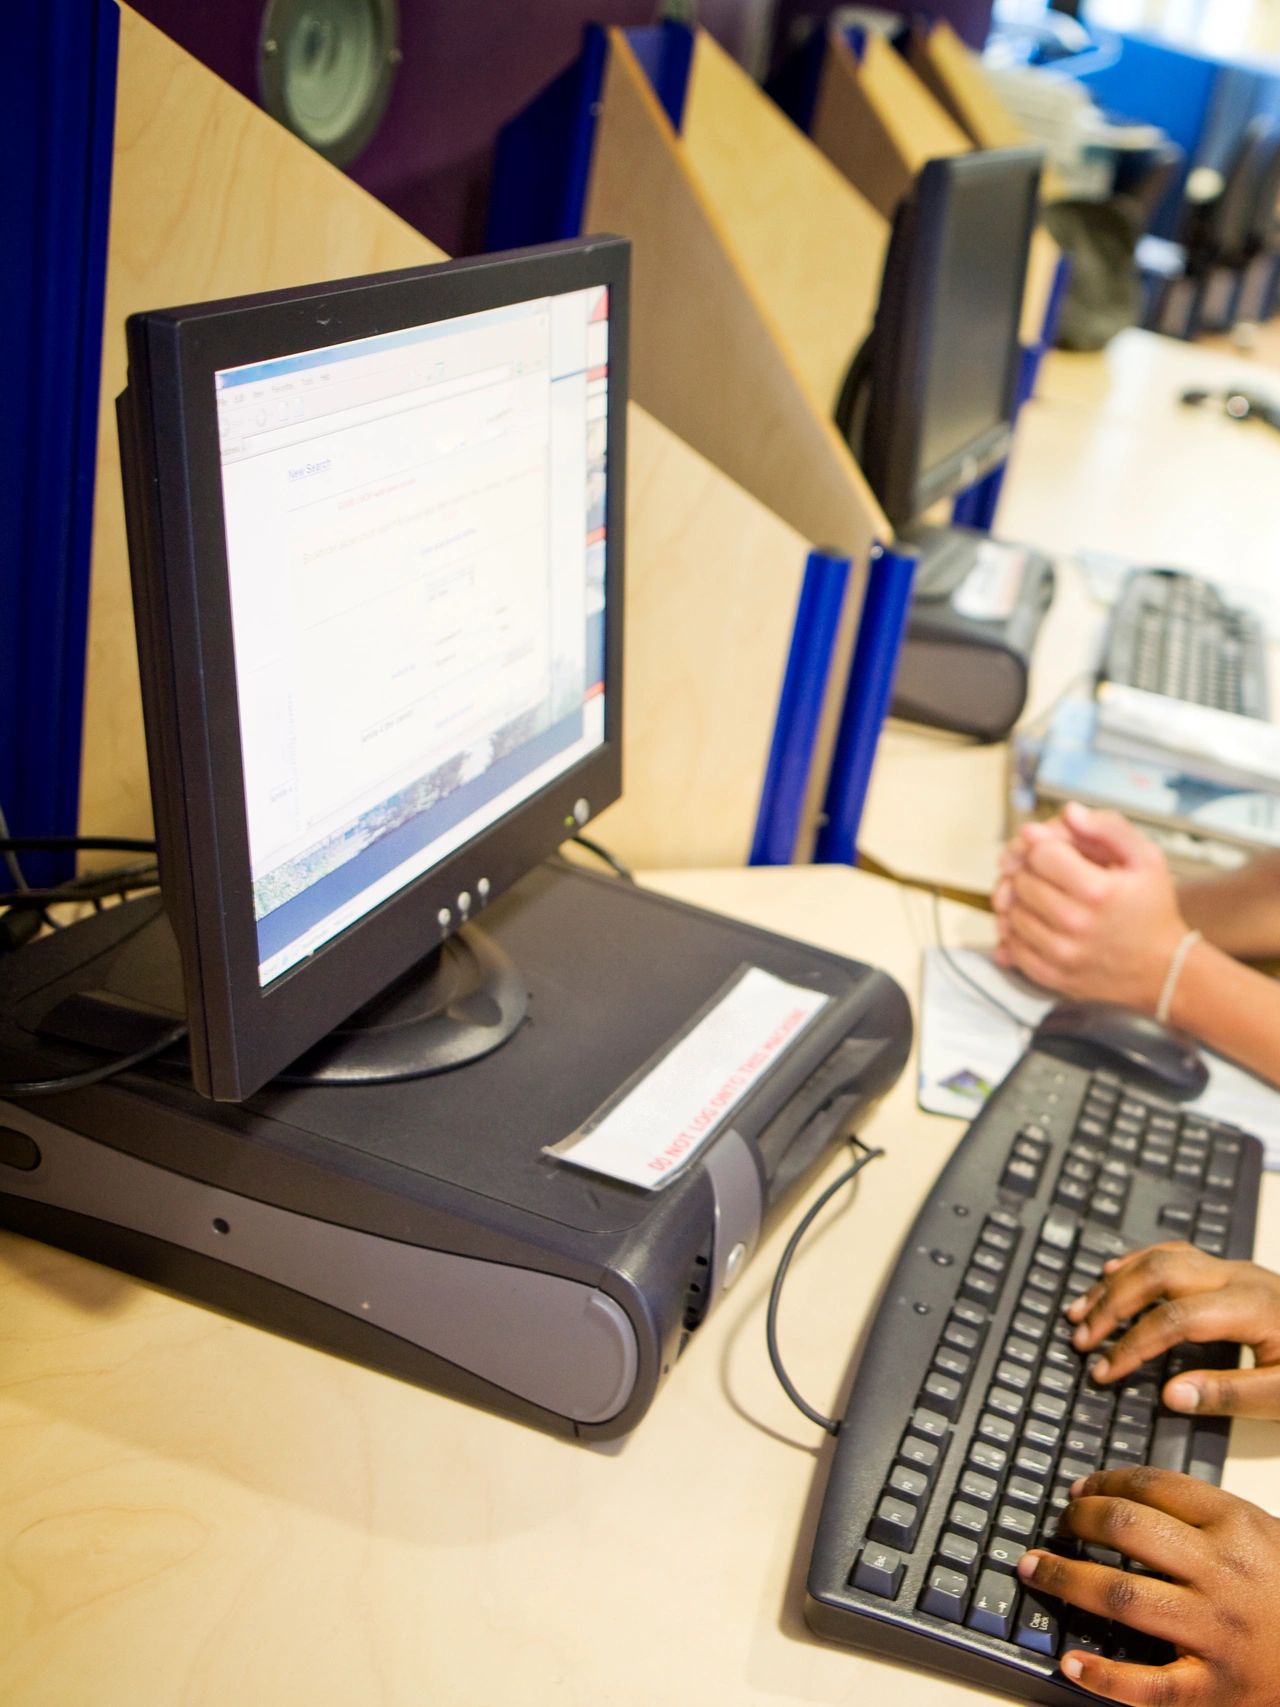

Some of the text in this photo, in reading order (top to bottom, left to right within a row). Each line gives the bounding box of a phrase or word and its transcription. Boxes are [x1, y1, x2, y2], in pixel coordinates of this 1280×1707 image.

[647, 1156, 673, 1172] DO
[664, 1130, 695, 1157] NOT
[688, 1107, 718, 1133] LOG
[709, 1074, 746, 1107] ONTO
[993, 1549, 1008, 1560] Q
[1029, 1612, 1042, 1628] Caps
[1039, 1616, 1049, 1630] Lock
